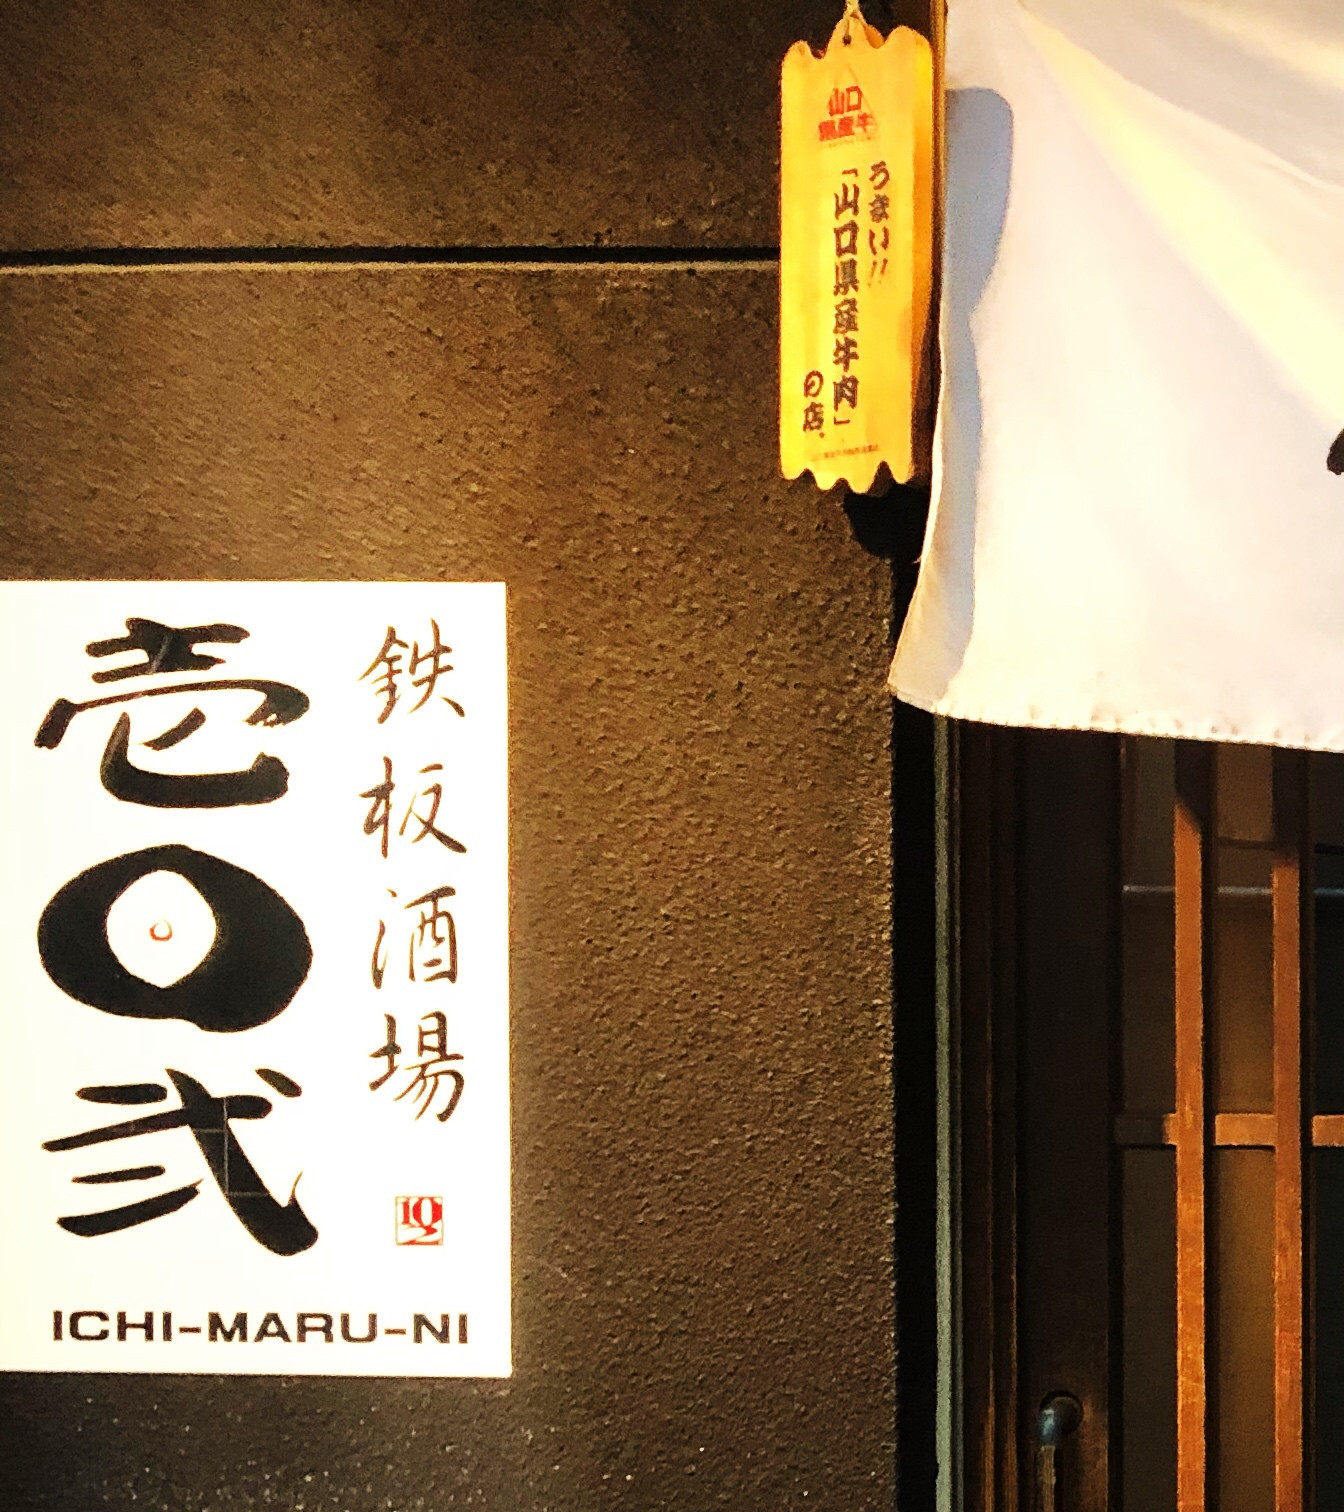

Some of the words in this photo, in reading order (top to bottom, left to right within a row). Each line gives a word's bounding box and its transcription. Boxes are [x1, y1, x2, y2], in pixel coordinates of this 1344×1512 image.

[828, 86, 862, 115] 山口
[359, 618, 467, 1123] 鉄板酒場
[52, 1310, 468, 1344] ICHI-MARU-NI
